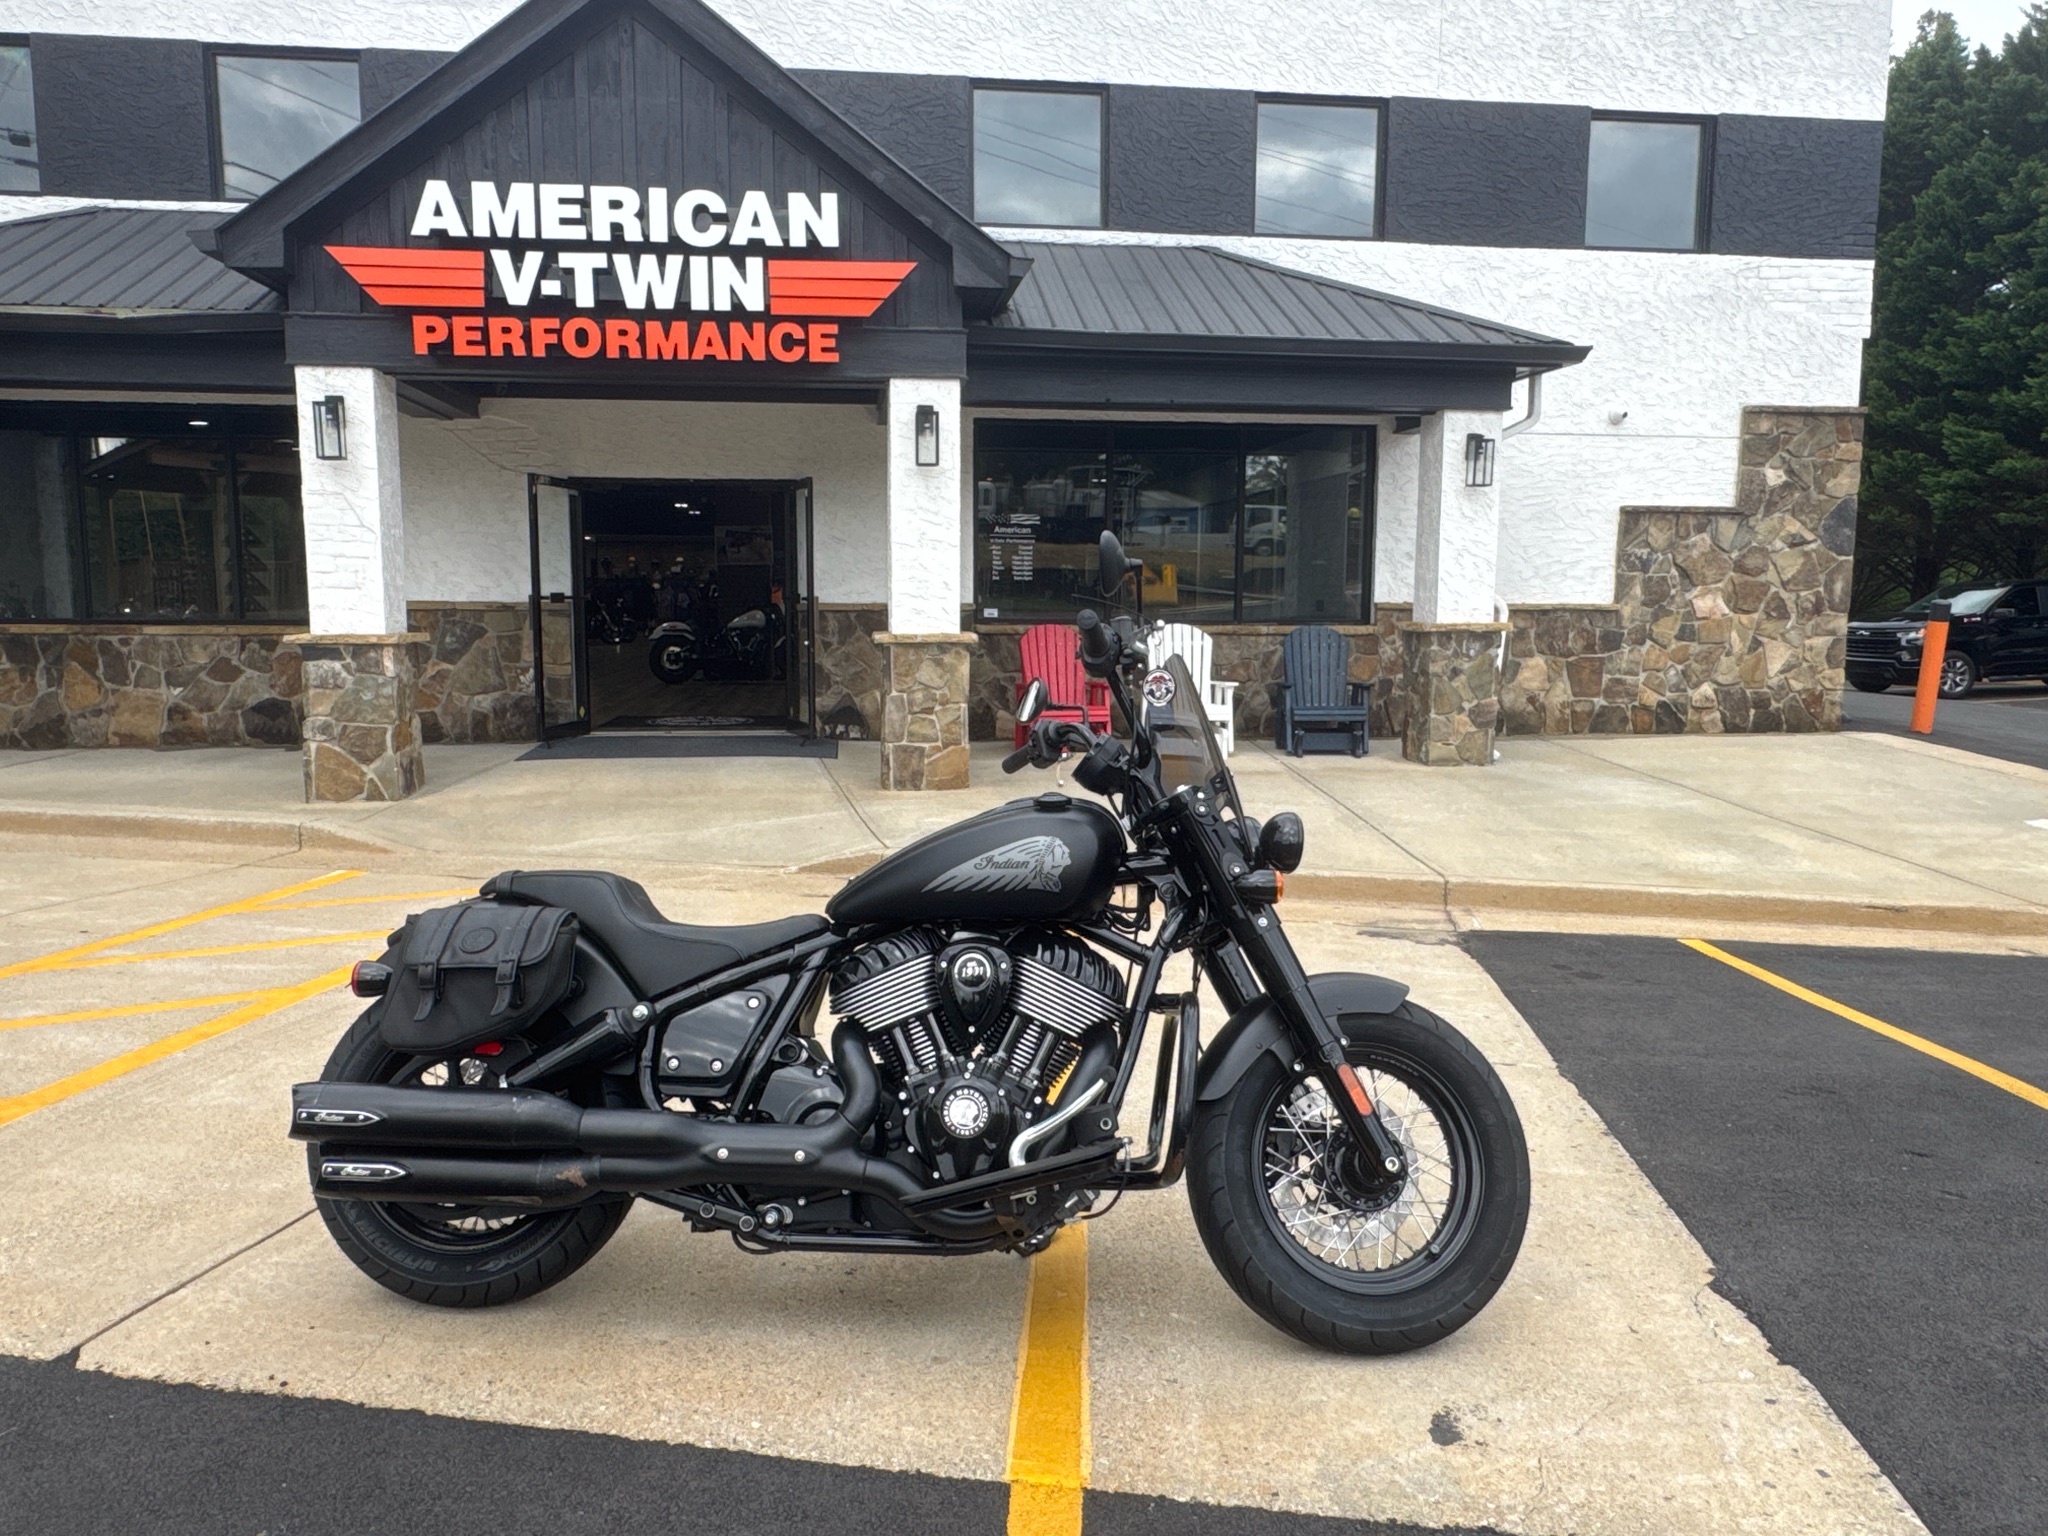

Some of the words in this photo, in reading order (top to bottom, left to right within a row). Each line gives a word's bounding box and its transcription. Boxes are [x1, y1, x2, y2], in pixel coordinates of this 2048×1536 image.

[410, 179, 840, 248] AMERICAN
[489, 248, 764, 312] V-TWIN
[411, 314, 840, 363] PERFORMANCE
[994, 526, 1031, 534] American
[974, 854, 1031, 870] Indian
[354, 1220, 438, 1274] MICHELIN
